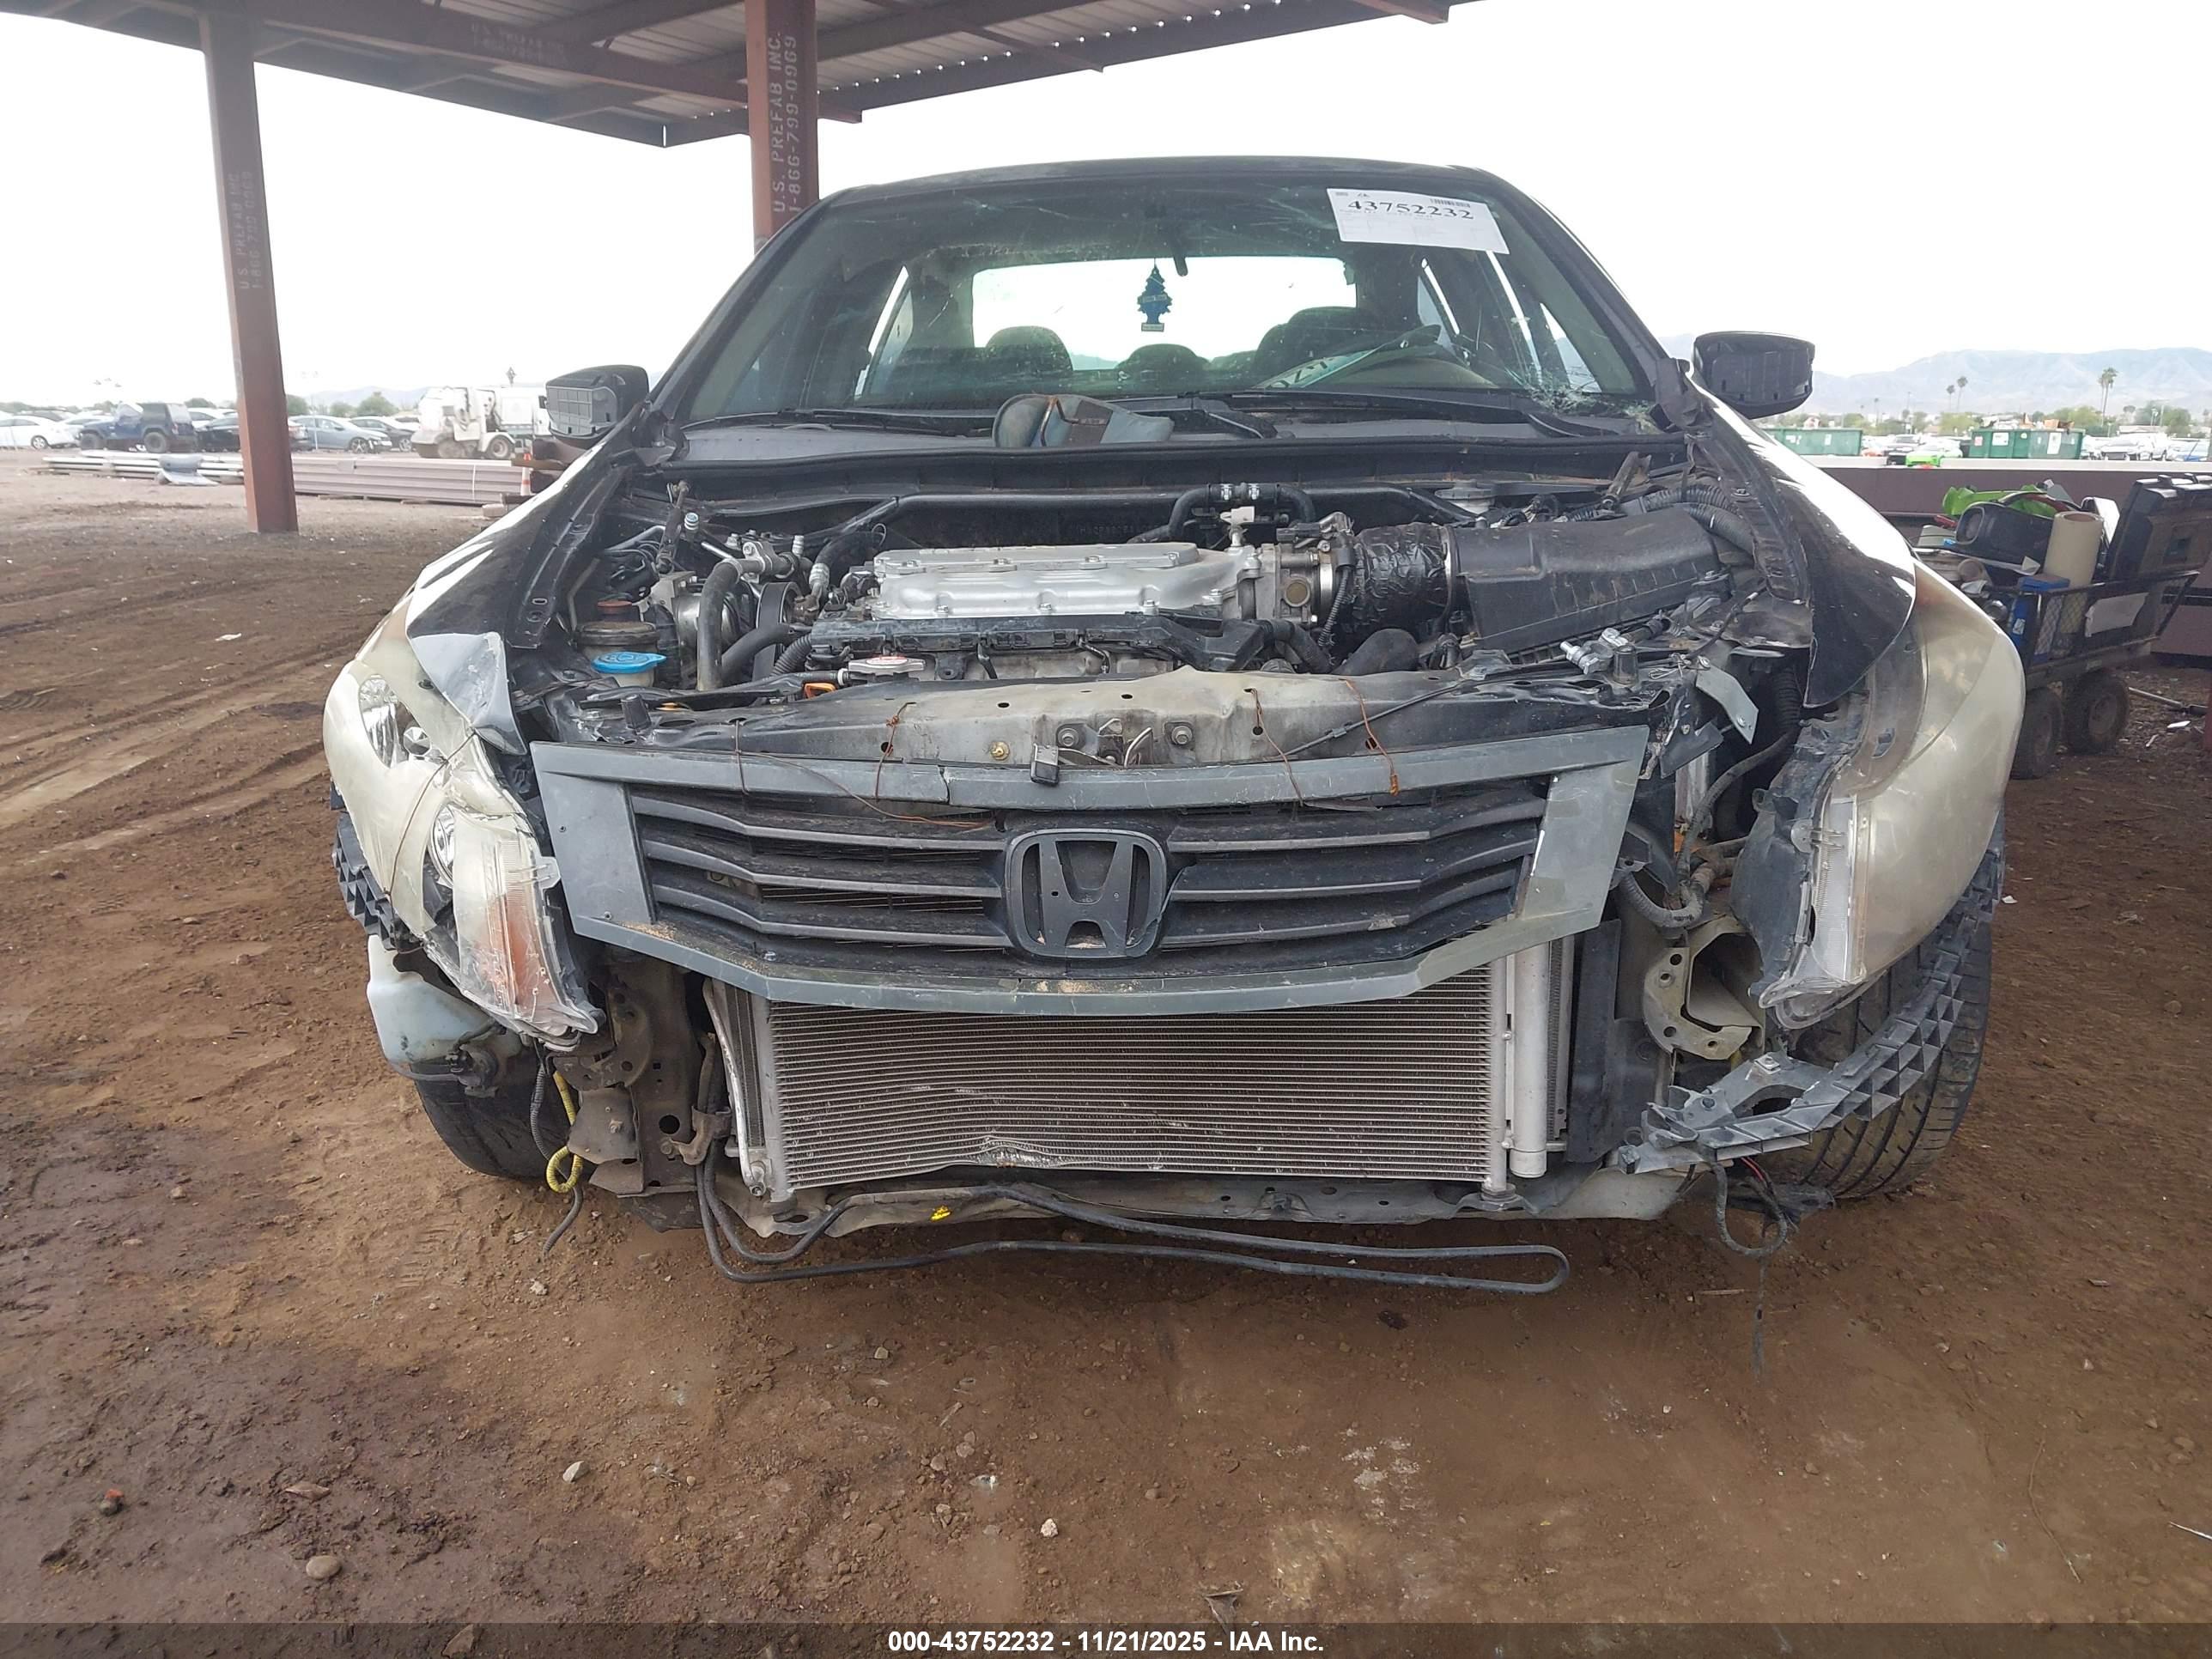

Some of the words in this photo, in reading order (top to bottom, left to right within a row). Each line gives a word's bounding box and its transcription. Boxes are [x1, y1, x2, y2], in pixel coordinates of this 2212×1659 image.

[767, 33, 782, 70] INC.
[769, 82, 785, 162] PREFAB
[784, 35, 802, 213] 1-866-799-0969
[773, 173, 786, 213] U.S.
[1347, 200, 1474, 220] 43752232
